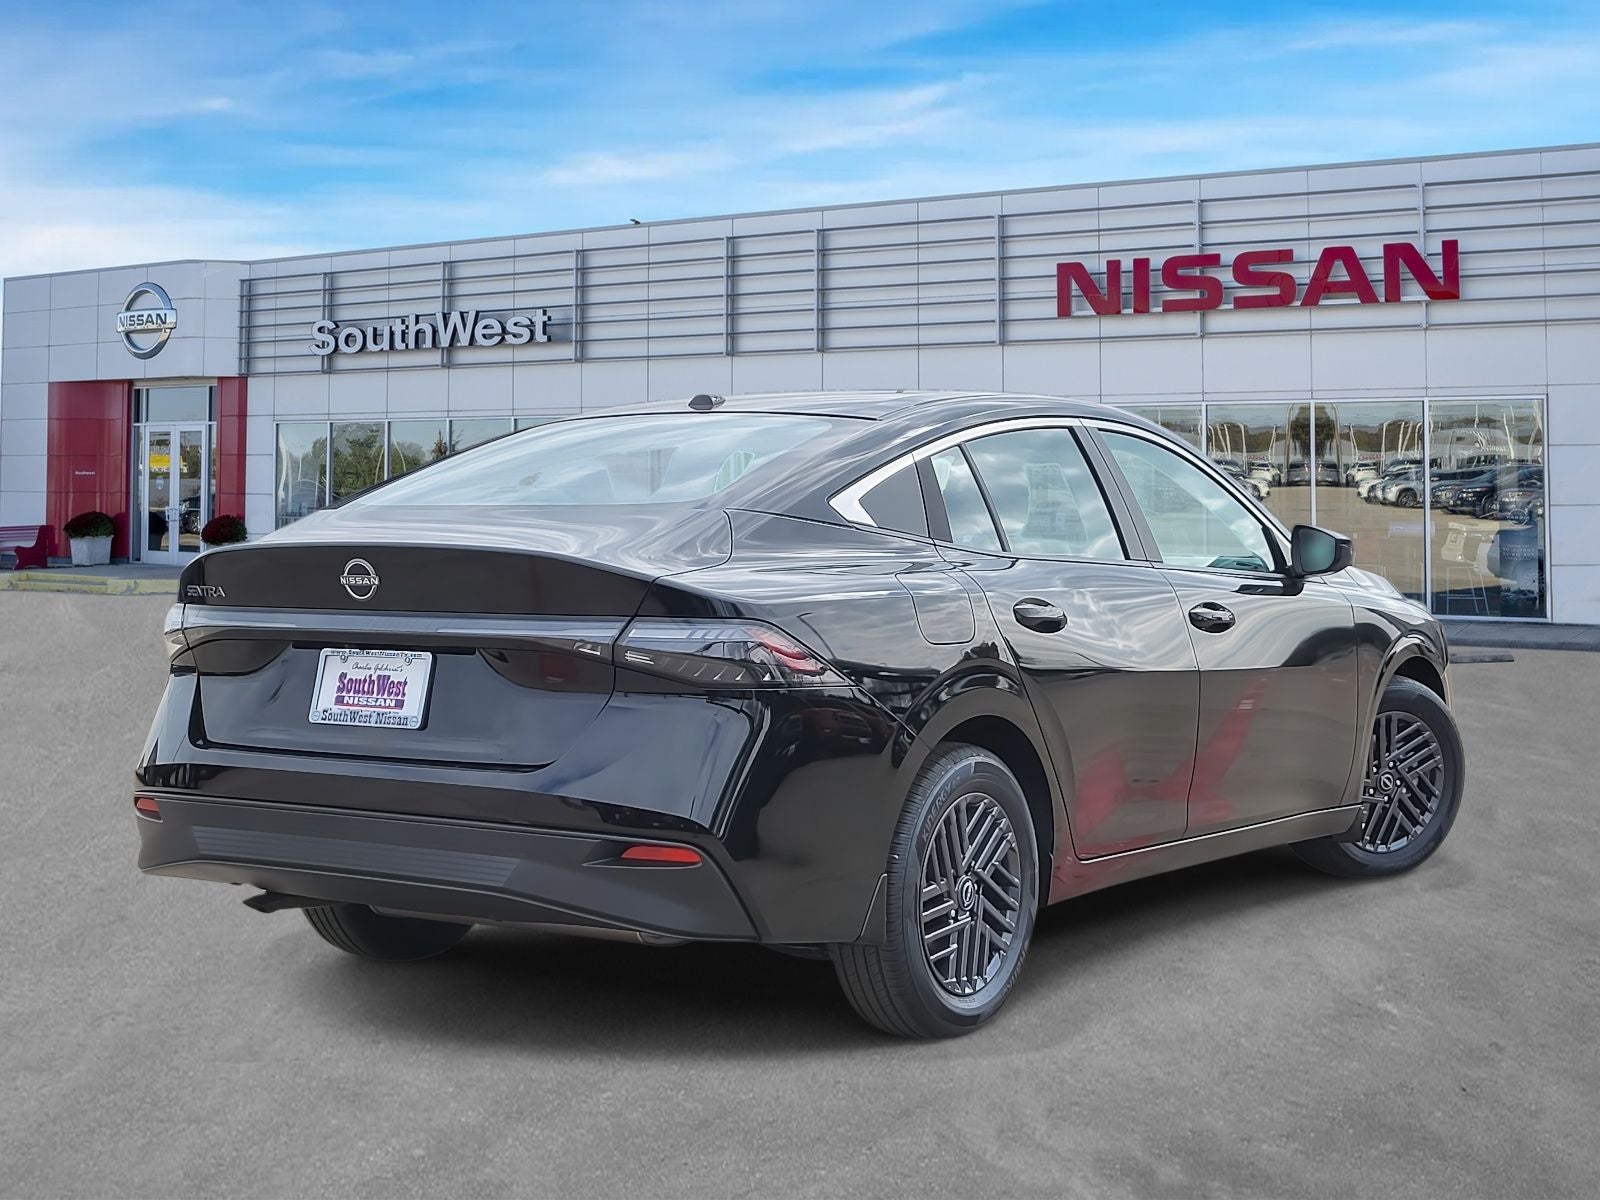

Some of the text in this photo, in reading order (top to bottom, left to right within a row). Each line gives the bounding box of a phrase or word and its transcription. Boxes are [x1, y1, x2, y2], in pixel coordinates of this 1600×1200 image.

[1057, 239, 1460, 318] NISSAN
[119, 313, 167, 328] NISSAN
[309, 308, 551, 355] SouthWest
[340, 577, 379, 585] NISSAN
[187, 585, 225, 597] SENTRA
[336, 672, 408, 698] SouthWest
[344, 697, 396, 706] NISSAN
[321, 707, 372, 724] SouthWest
[376, 712, 409, 726] Nissan
